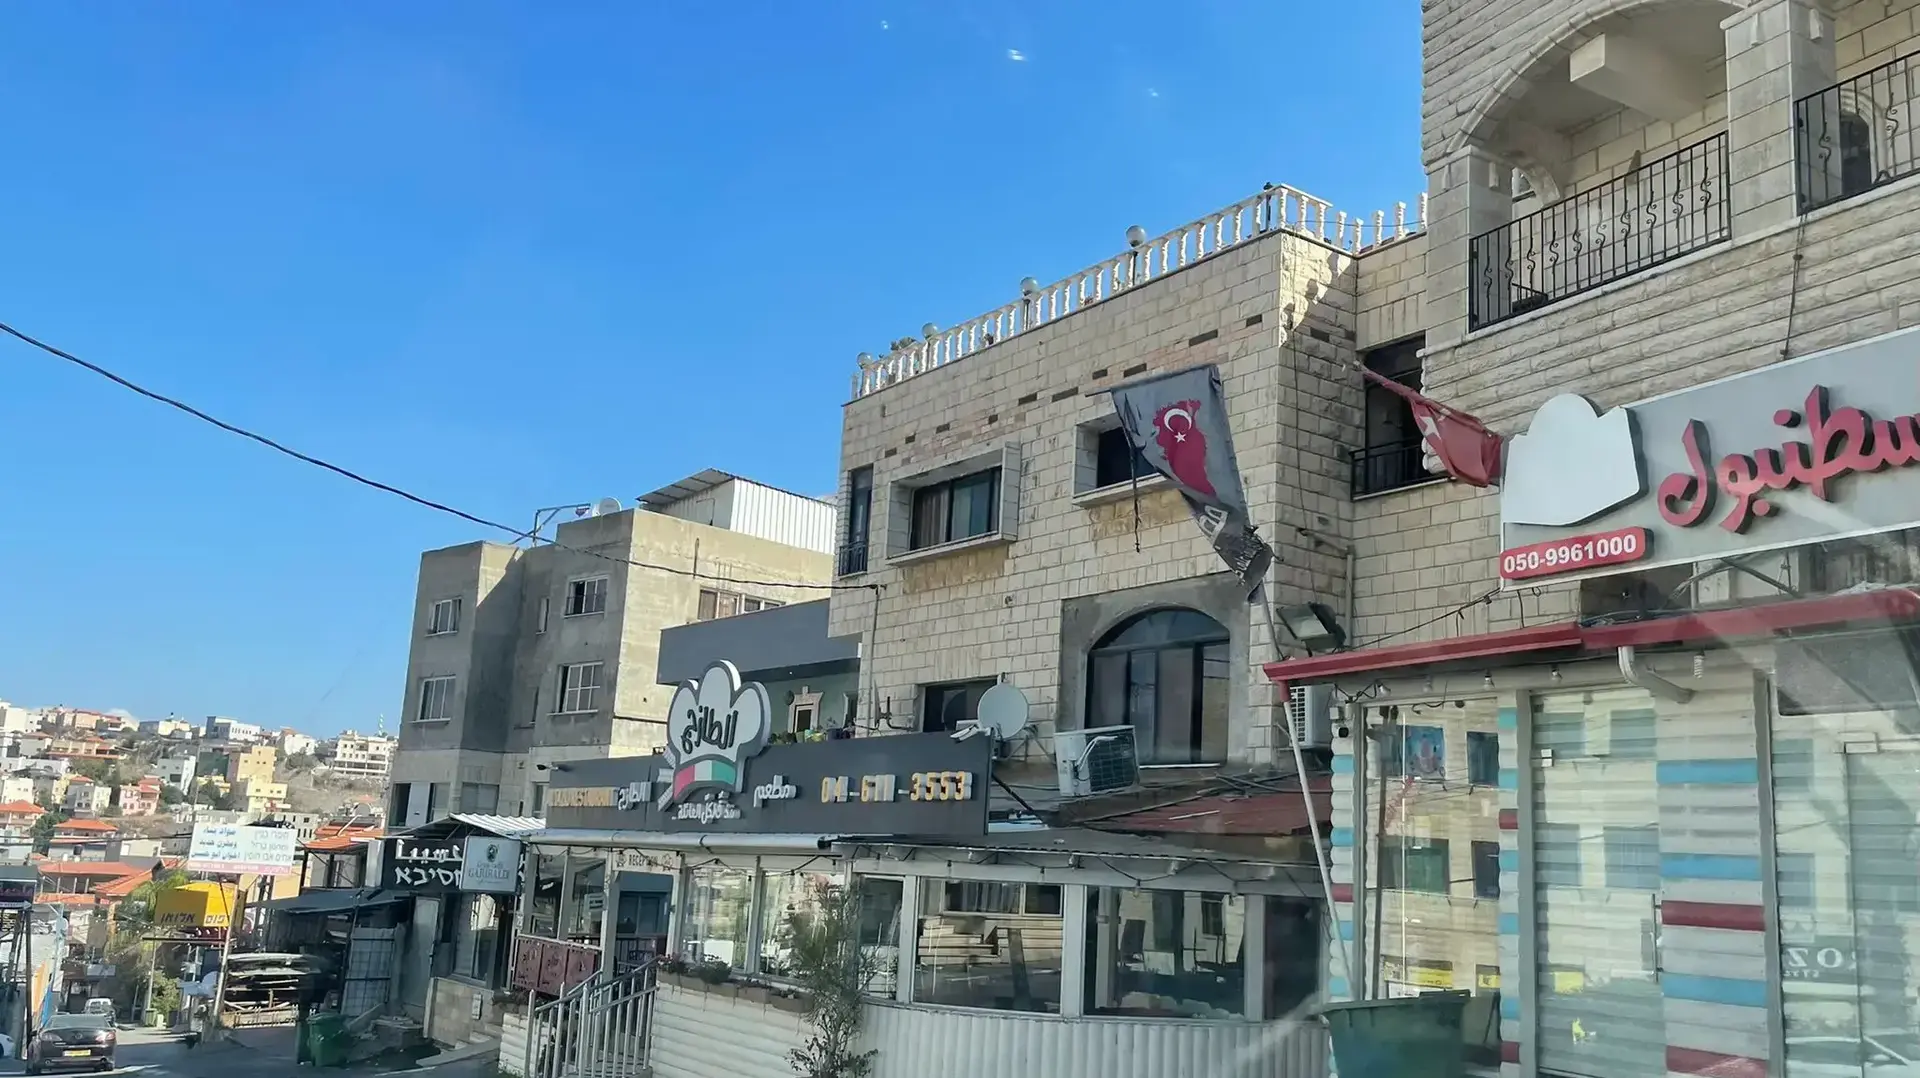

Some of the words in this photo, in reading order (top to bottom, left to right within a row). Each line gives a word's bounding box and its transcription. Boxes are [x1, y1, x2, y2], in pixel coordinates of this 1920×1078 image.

[1503, 534, 1637, 574] 050-9961000
[680, 705, 739, 755] الطازج
[753, 774, 797, 808] مطعم
